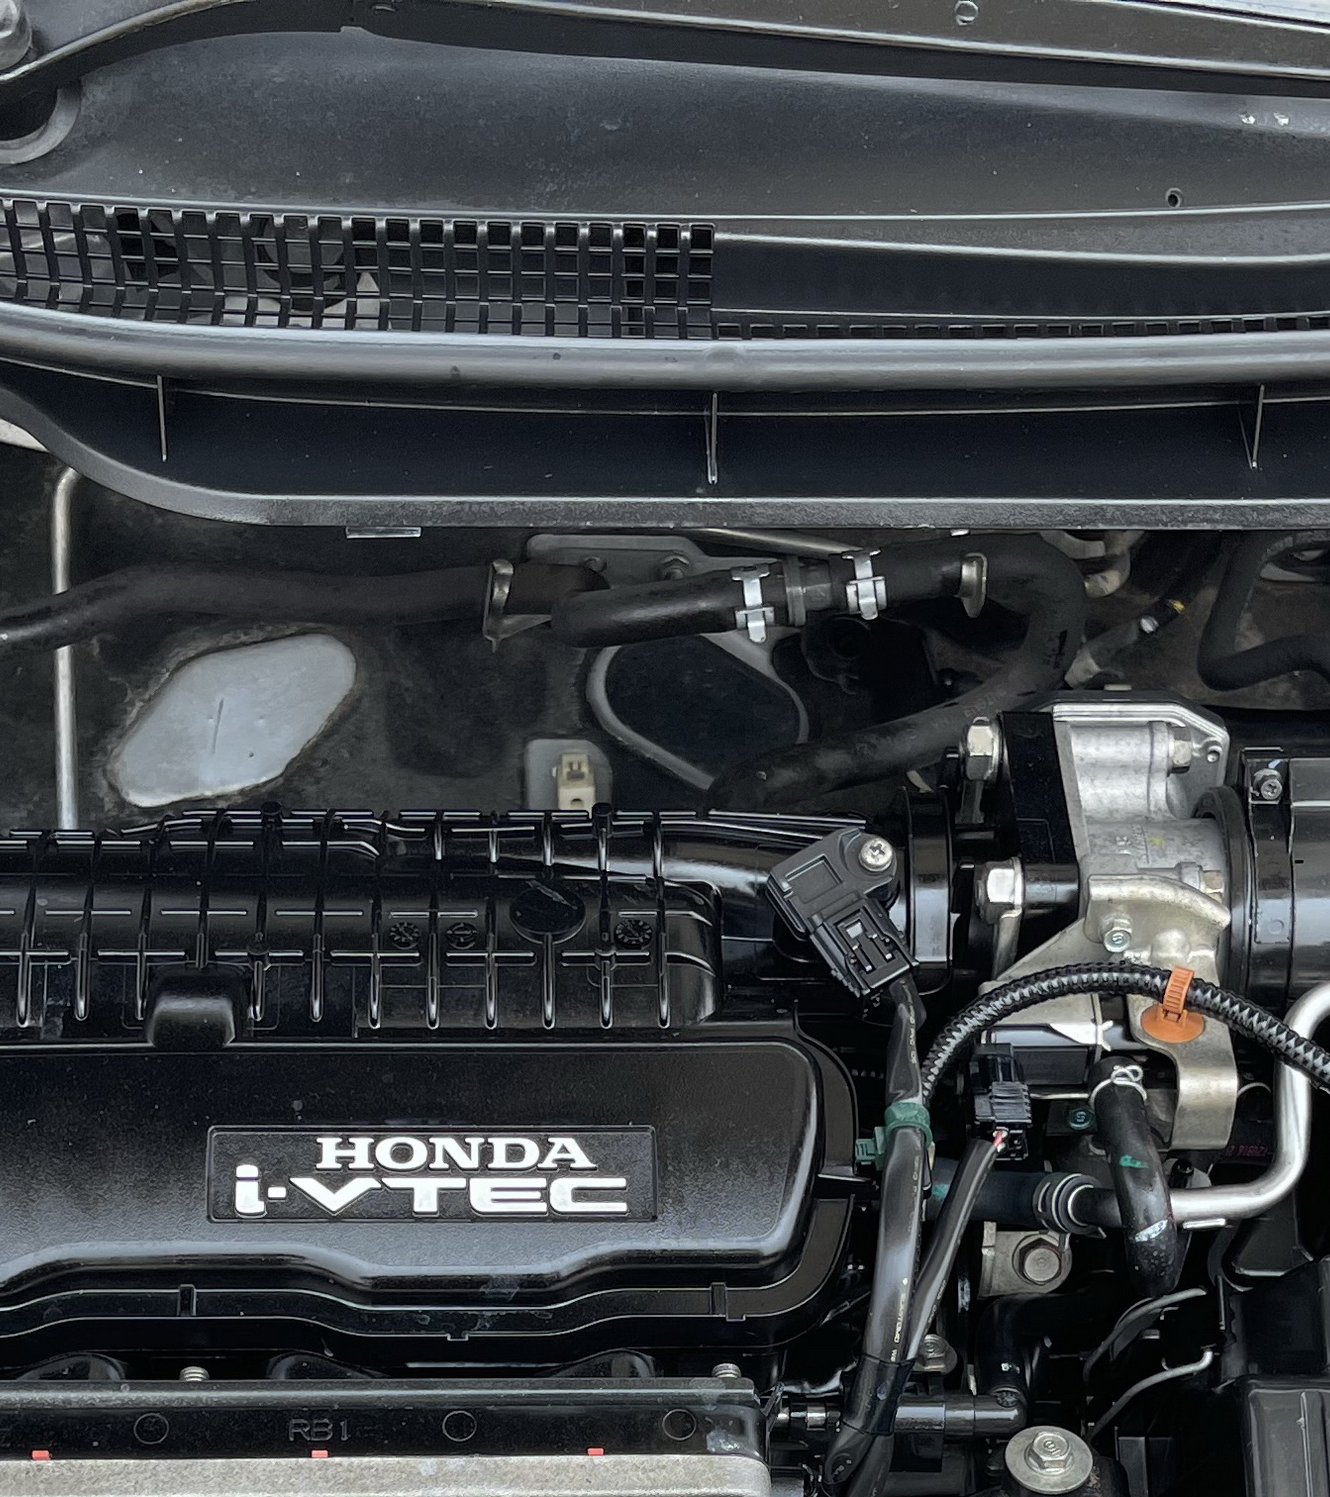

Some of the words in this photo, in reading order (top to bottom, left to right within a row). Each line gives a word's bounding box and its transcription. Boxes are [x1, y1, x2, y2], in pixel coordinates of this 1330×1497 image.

[314, 1136, 598, 1172] HONDA
[234, 1163, 629, 1217] i-VTEC
[288, 1418, 350, 1442] RB1
